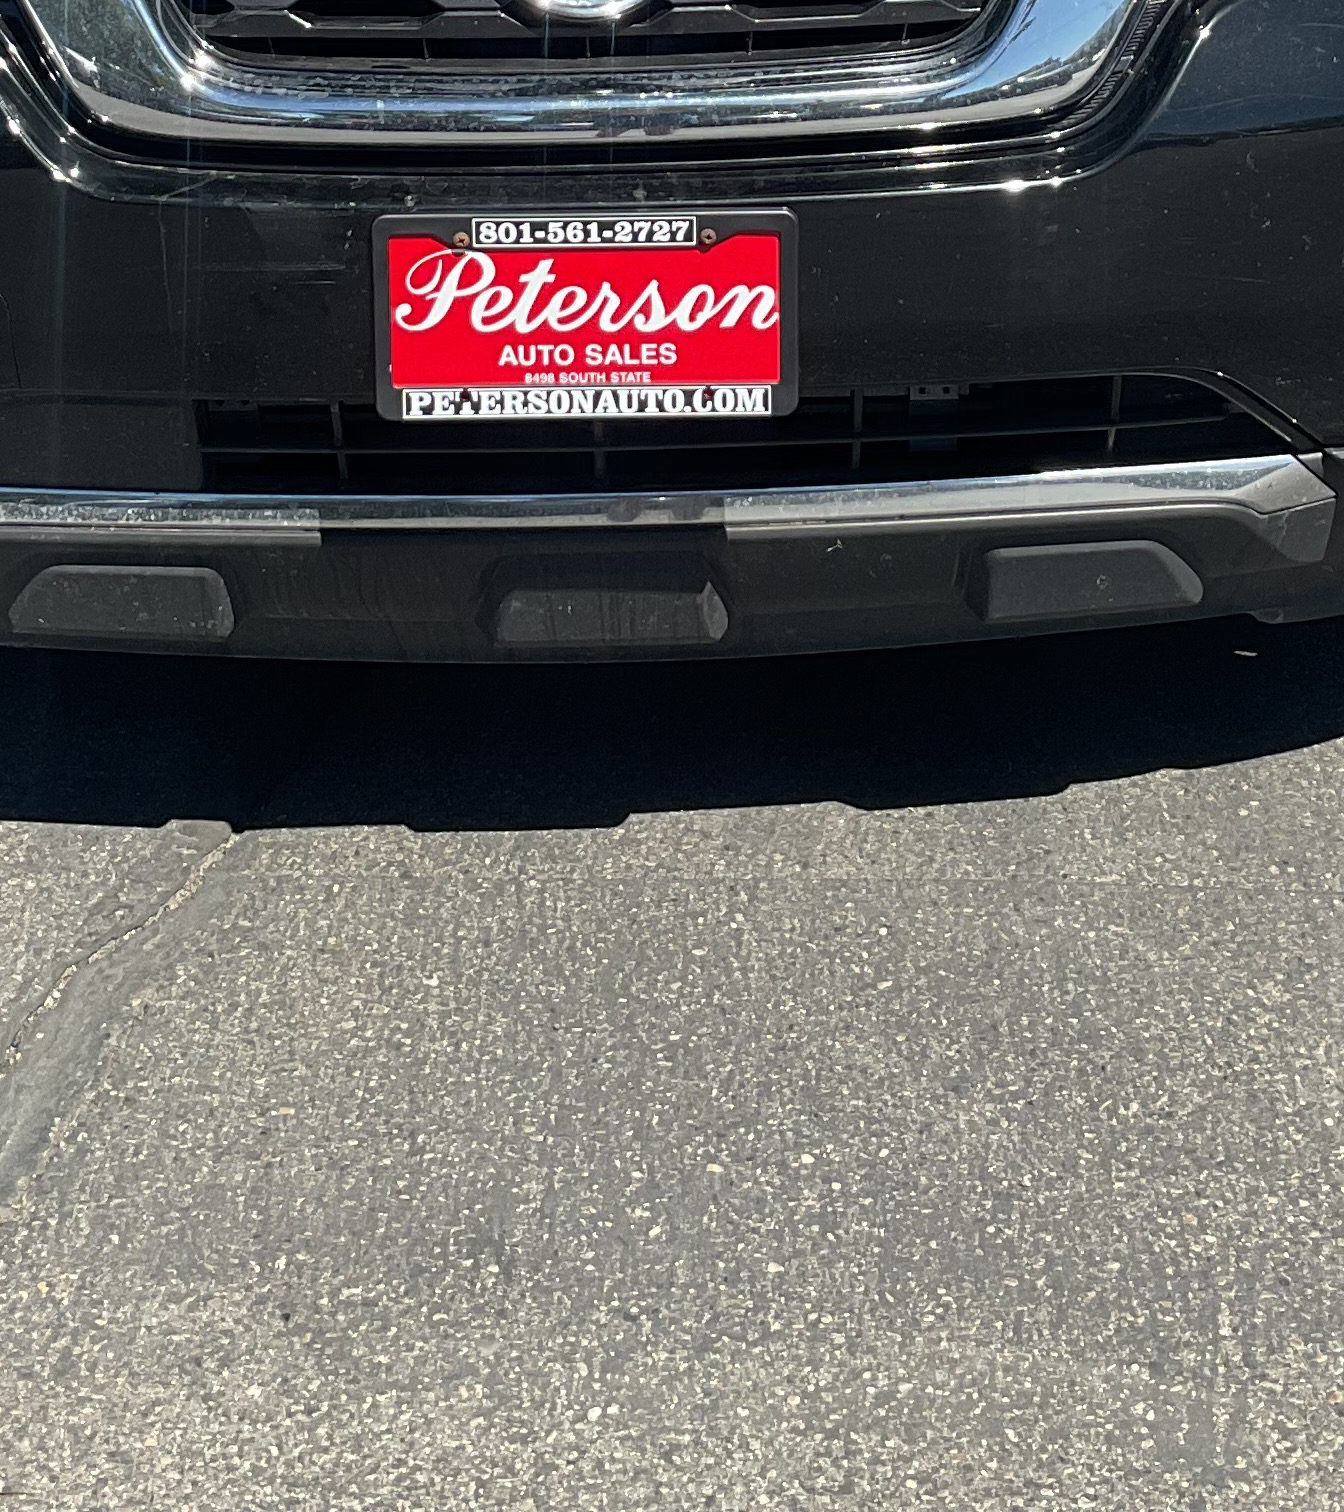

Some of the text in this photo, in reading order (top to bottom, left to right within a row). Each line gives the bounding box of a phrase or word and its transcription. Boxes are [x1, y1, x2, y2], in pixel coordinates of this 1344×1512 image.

[479, 219, 691, 244] 801-561-2727
[394, 248, 780, 334] Peterson
[498, 343, 678, 366] AUTO SALES
[559, 372, 607, 384] SOUTH
[610, 371, 652, 383] STATE
[408, 388, 767, 416] PETERSONAUTO.COM
